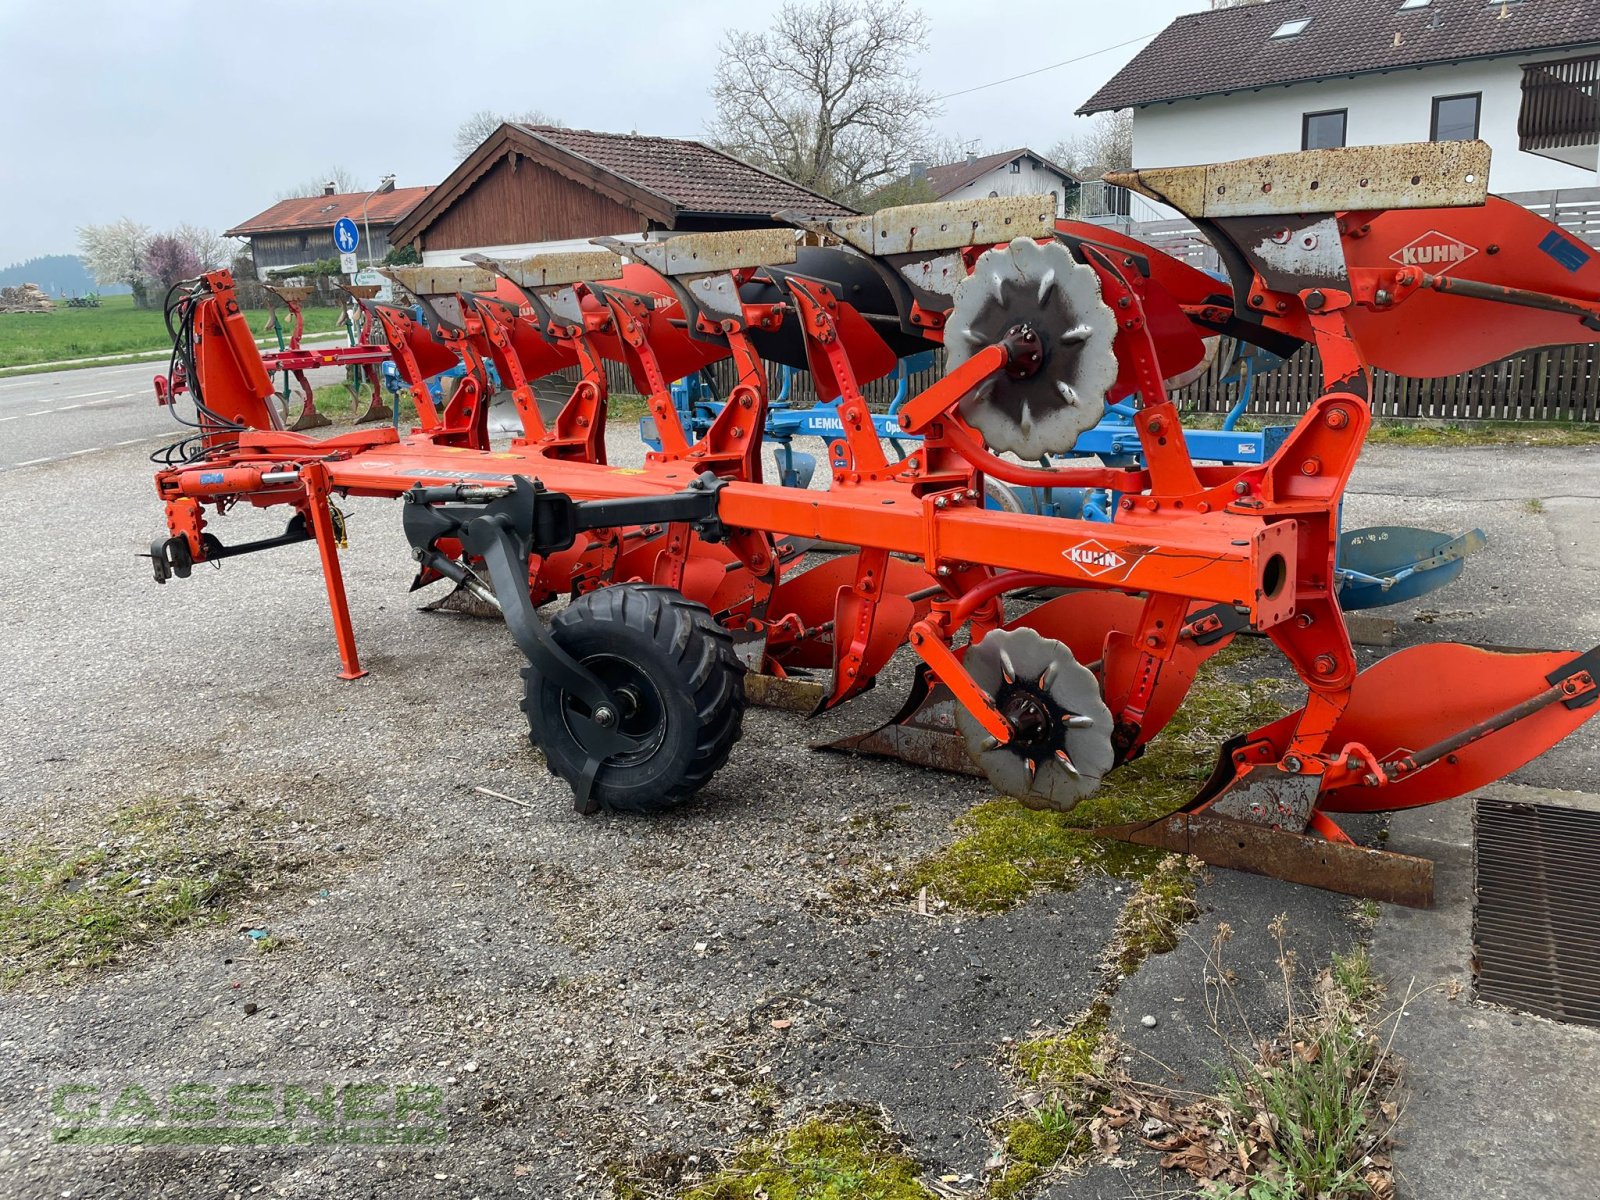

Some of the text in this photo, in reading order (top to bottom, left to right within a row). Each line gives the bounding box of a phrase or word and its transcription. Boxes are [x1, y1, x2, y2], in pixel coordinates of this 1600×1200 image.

[1402, 244, 1465, 264] KUHN
[885, 420, 903, 435] Opa
[1070, 548, 1117, 567] KUHN
